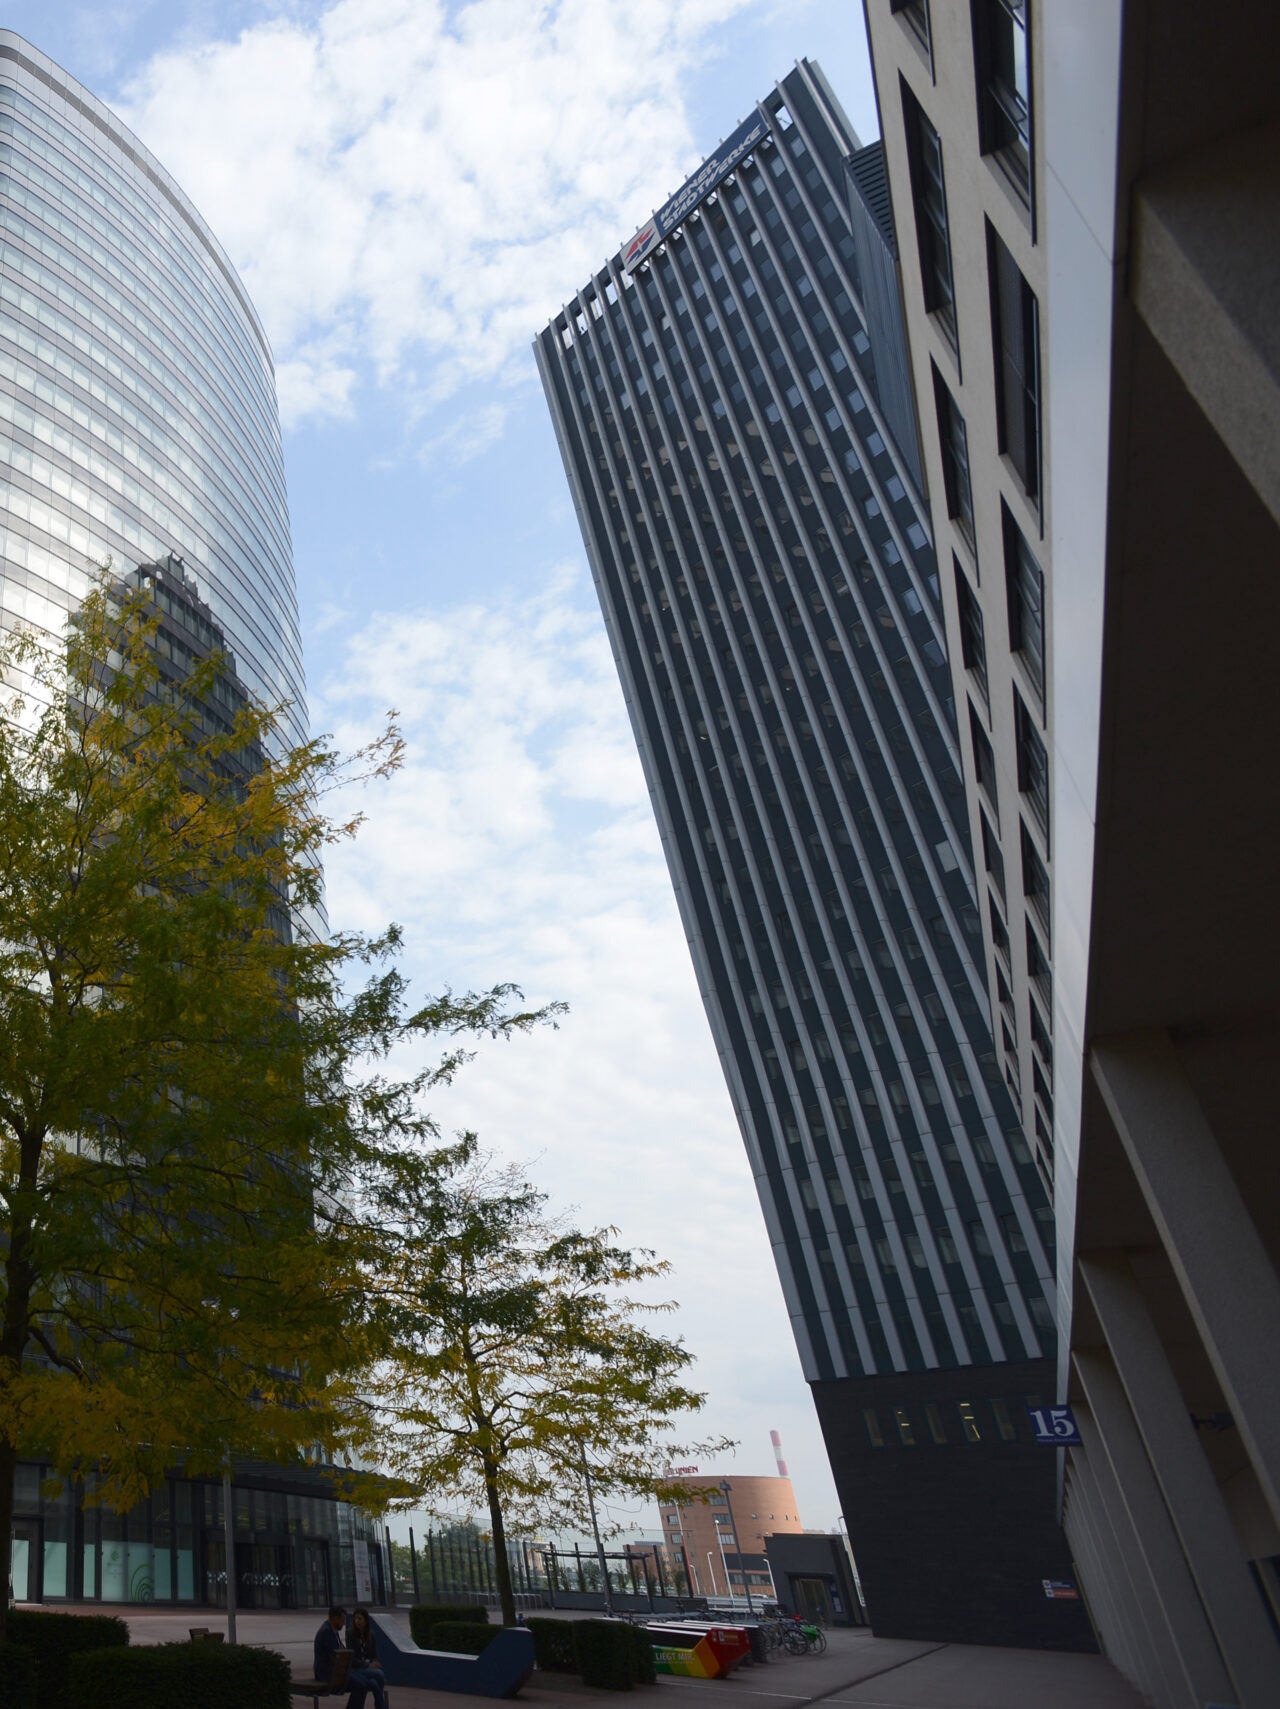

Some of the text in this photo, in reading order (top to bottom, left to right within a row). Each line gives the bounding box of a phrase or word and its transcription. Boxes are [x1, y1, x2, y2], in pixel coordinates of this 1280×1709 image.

[660, 159, 720, 222] WIENER
[662, 123, 761, 230] STADTWERKE
[1030, 1410, 1075, 1437] 15
